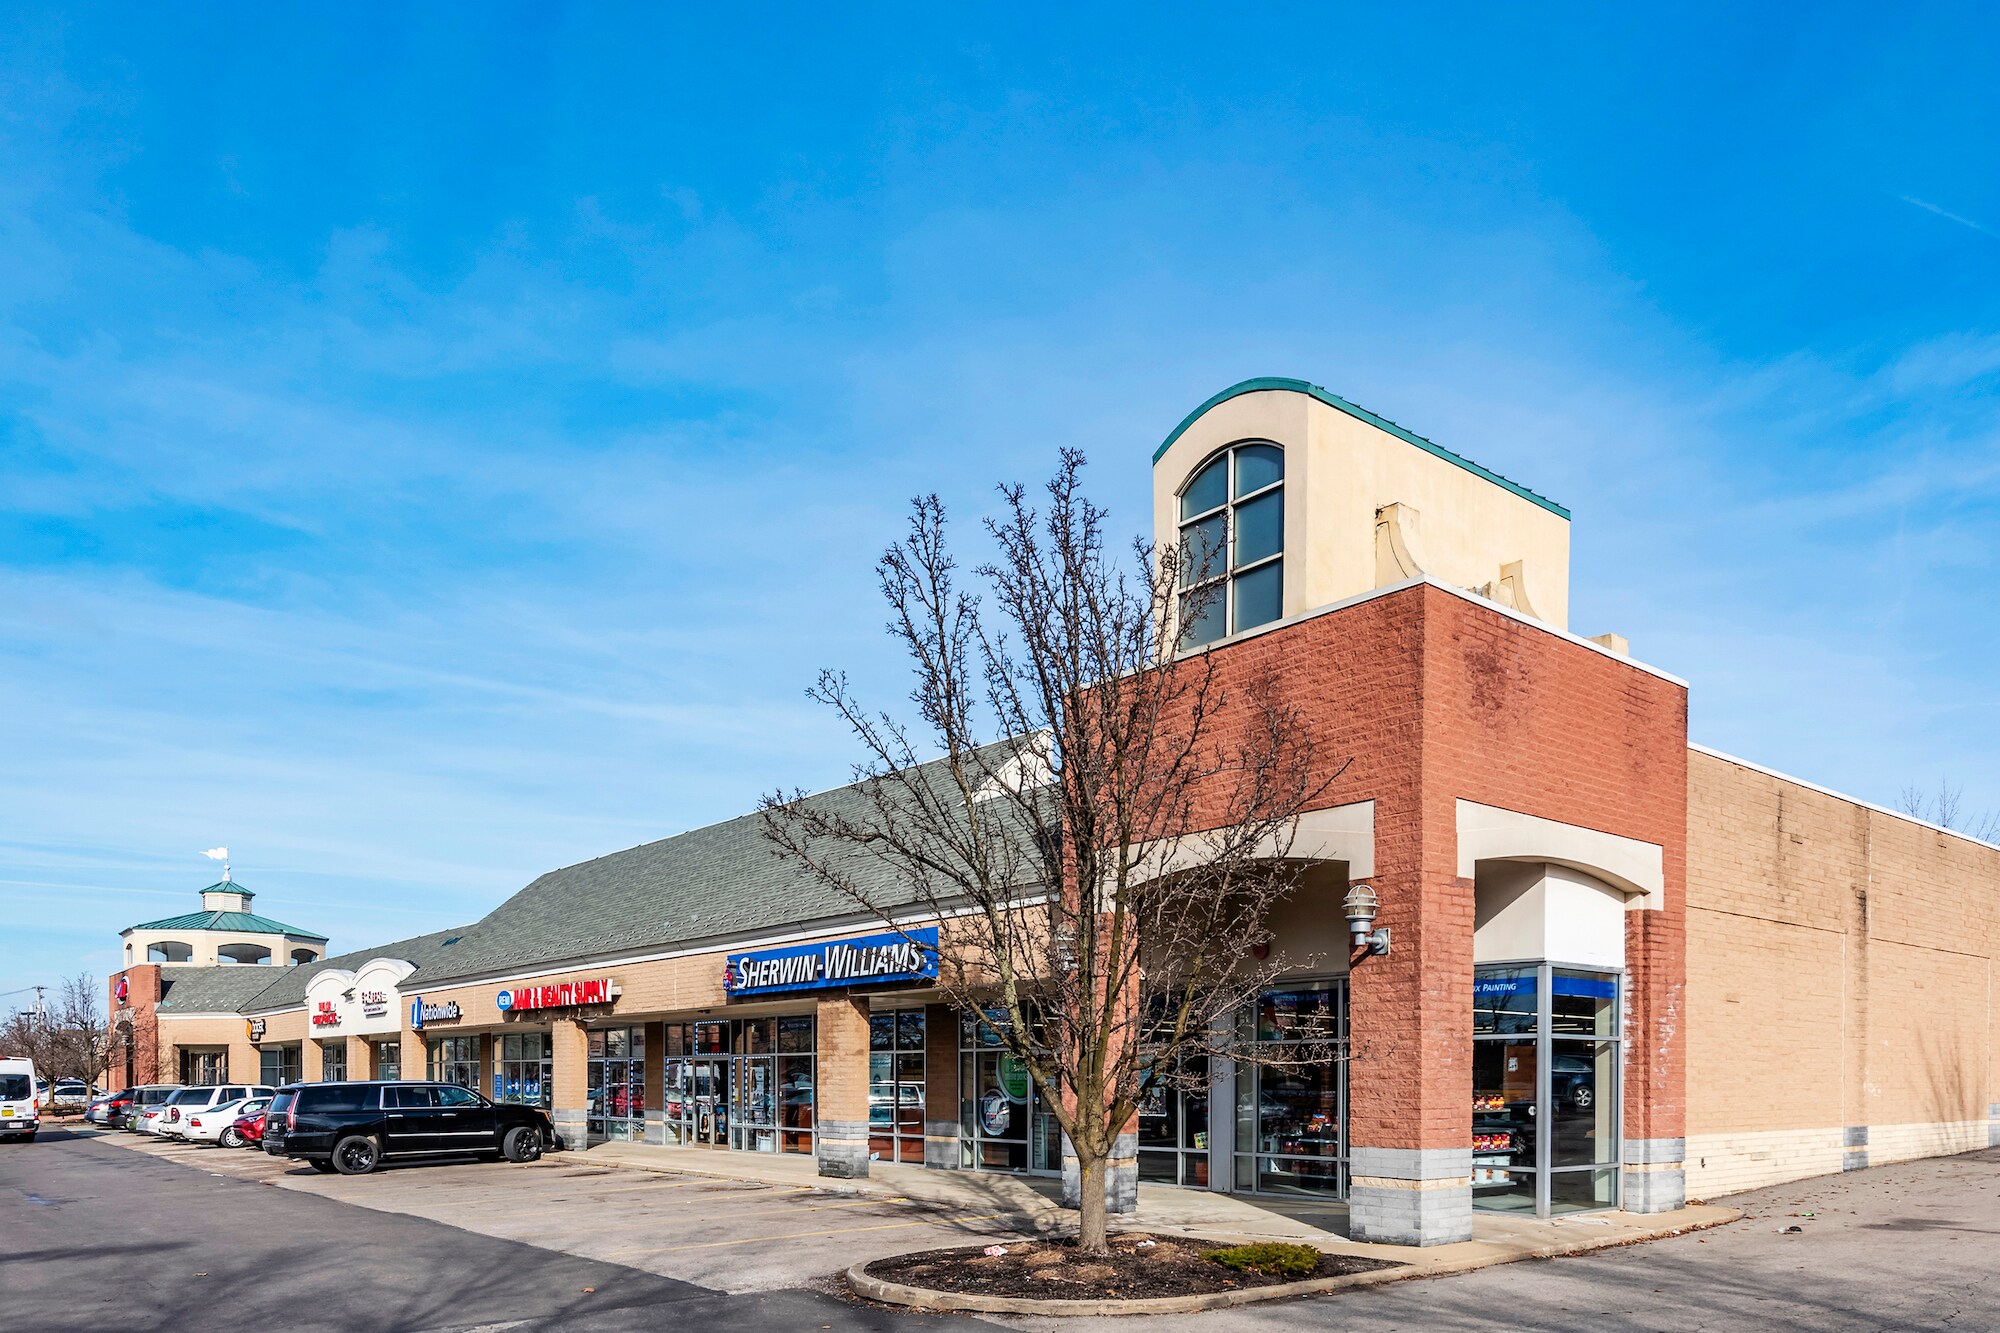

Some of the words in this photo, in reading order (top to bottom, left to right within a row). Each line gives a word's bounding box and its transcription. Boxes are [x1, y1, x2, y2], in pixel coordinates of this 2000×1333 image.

[513, 988, 532, 1011] HAIR
[541, 983, 573, 1008] BEAUTY
[575, 979, 609, 1005] SUPPLY
[1482, 982, 1517, 992] PAINTING
[420, 1001, 458, 1021] Nationwide
